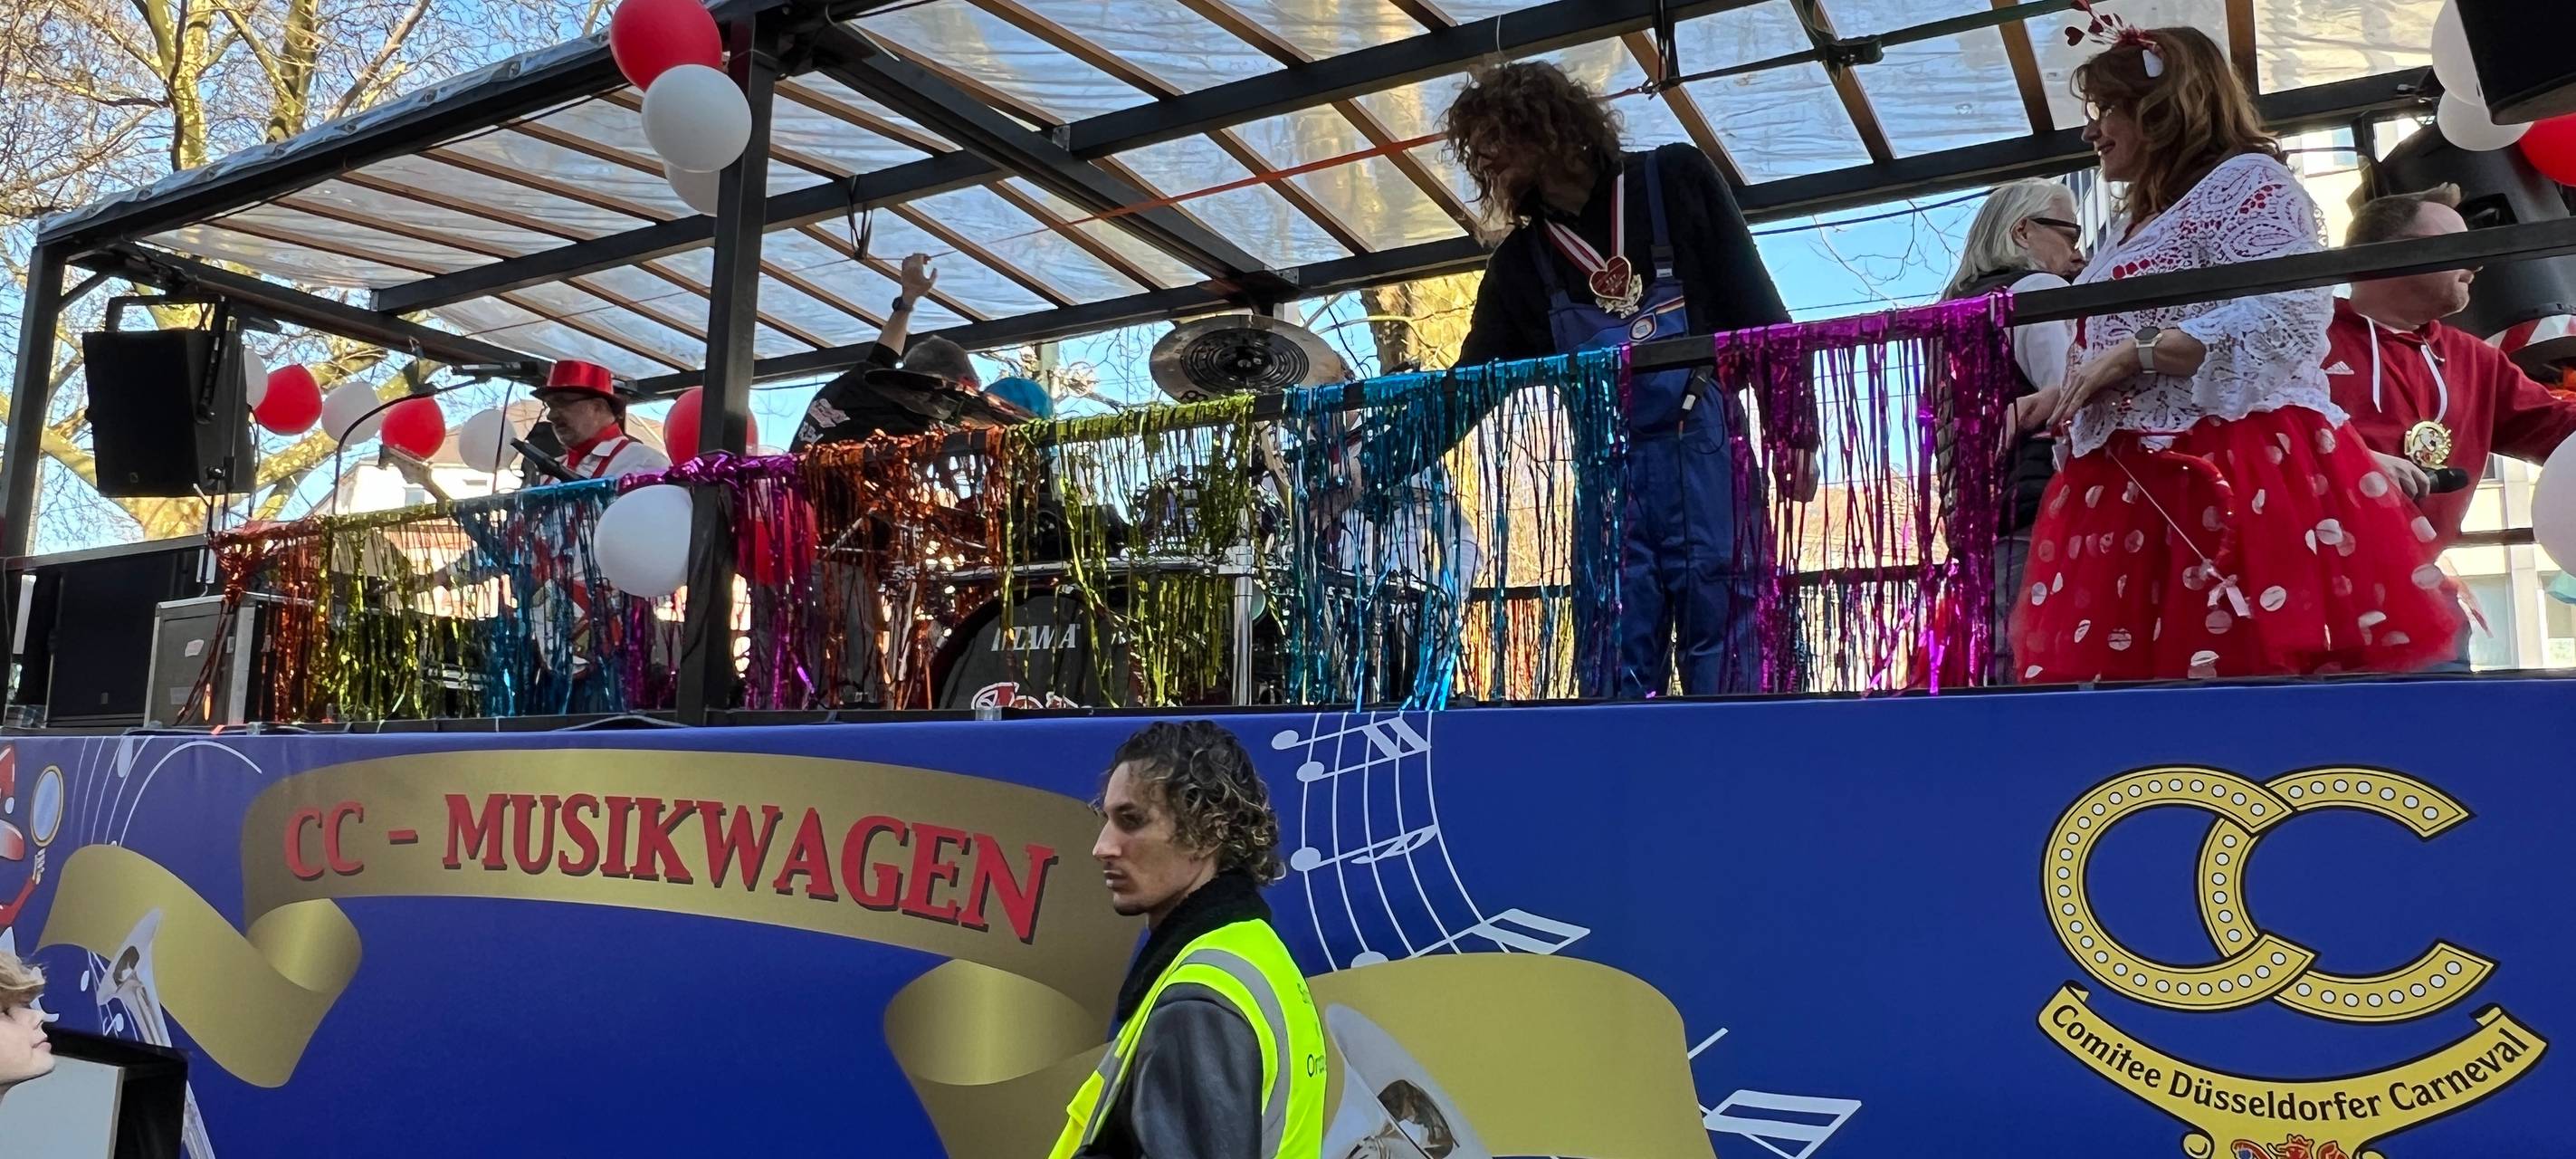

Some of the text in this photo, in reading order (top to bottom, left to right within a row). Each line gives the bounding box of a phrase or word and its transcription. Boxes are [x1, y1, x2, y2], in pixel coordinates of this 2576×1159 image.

[284, 801, 365, 881] CC
[442, 793, 1059, 944] MUSIKWAGEN
[2052, 1003, 2531, 1121] Comitee Düsseldorfer Carneval
